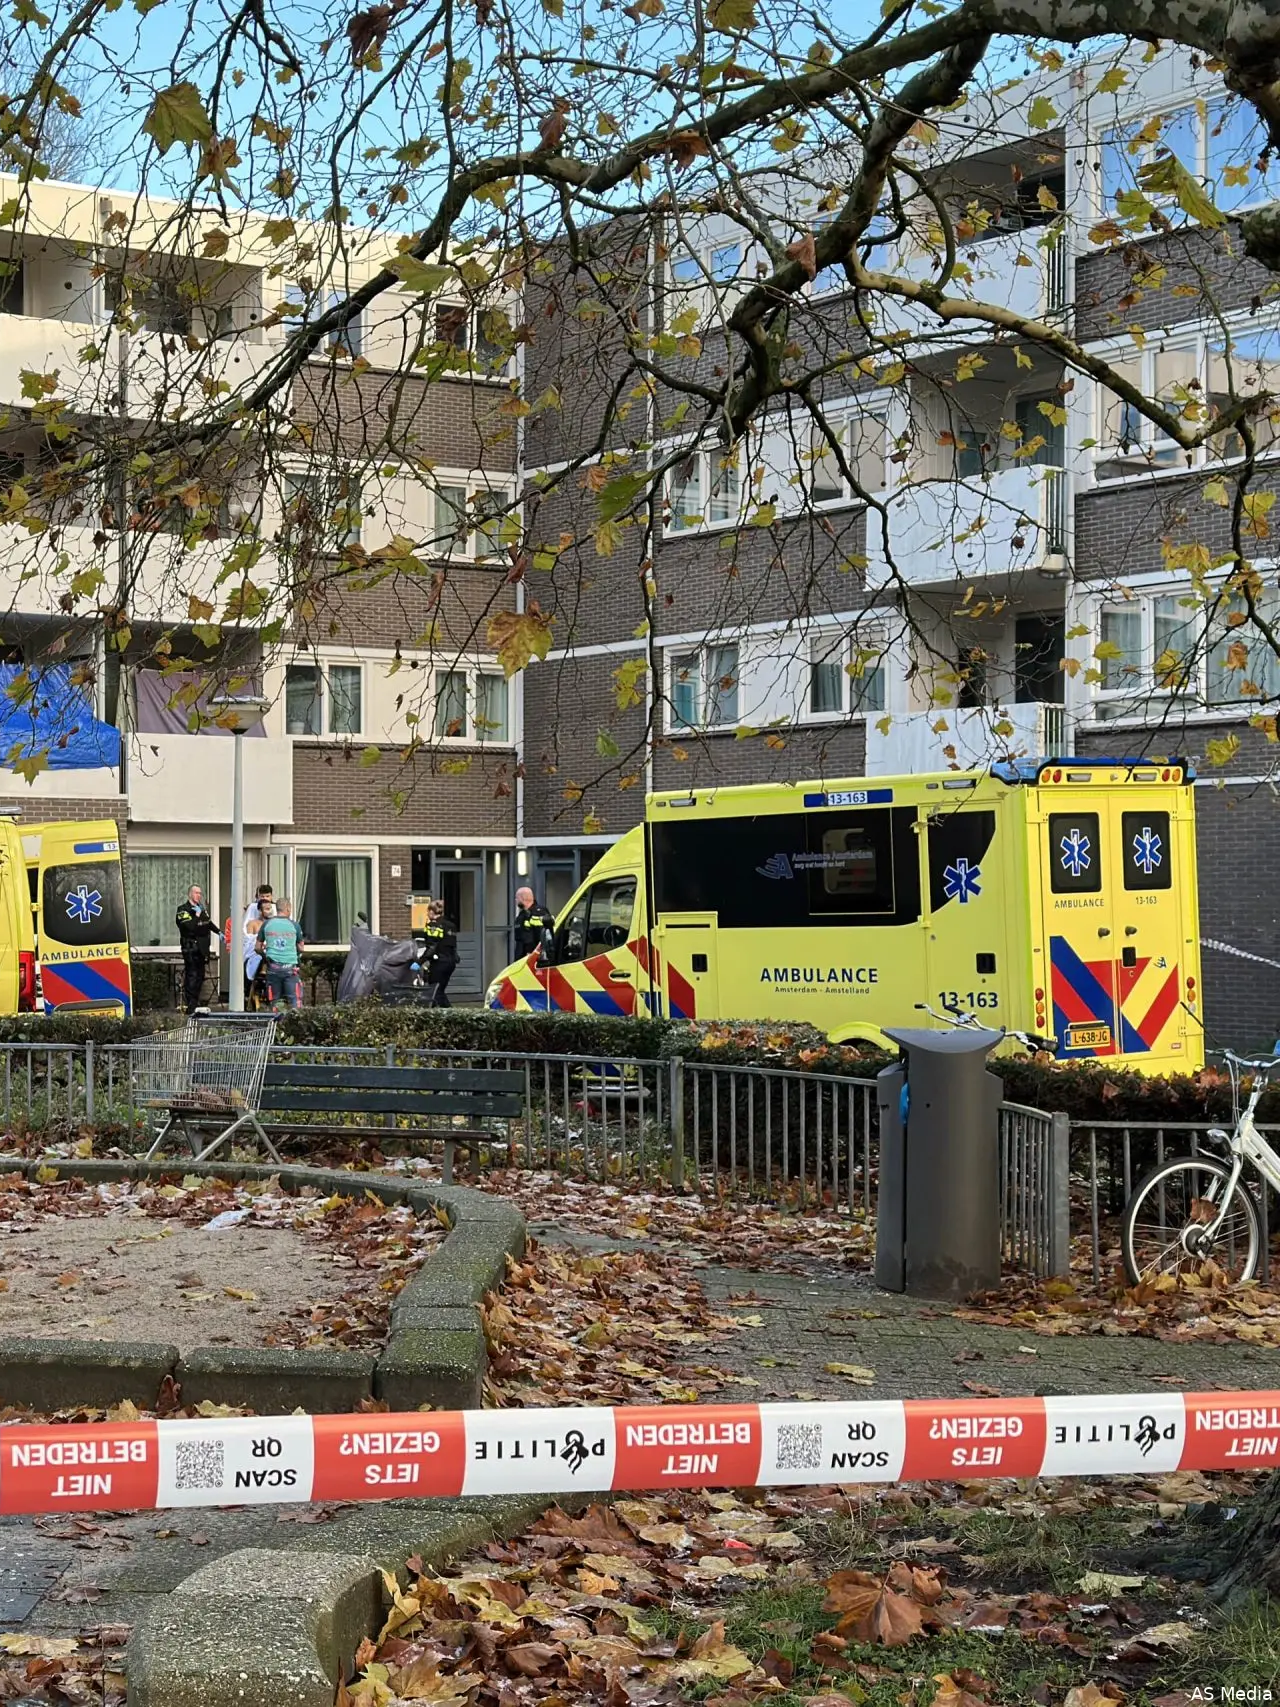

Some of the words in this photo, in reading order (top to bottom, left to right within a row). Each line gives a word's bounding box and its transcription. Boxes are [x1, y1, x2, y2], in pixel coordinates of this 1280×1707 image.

[830, 792, 866, 805] 13-163
[1054, 898, 1105, 909] AMBULANCE
[1135, 896, 1157, 905] 13-163
[41, 946, 120, 962] AMBULANCE
[760, 968, 879, 983] AMBULANCE
[775, 986, 818, 994] Amsterdam
[825, 986, 870, 994] Amstelland
[938, 991, 999, 1008] 13-163
[1074, 1030, 1108, 1044] L-638-JG
[626, 1423, 751, 1446] BETREDEN
[847, 1421, 876, 1441] QR
[928, 1417, 1023, 1439] GEZIEN?
[252, 1438, 282, 1458] QR
[339, 1431, 440, 1455] GEZIEN?
[1225, 1437, 1279, 1457] NIET
[11, 1440, 147, 1467] BETREDEN
[831, 1451, 889, 1469] SCAN
[951, 1447, 1003, 1466] IETS
[365, 1463, 419, 1484] IETS
[661, 1454, 718, 1475] NIET
[51, 1473, 112, 1497] NIET
[235, 1469, 297, 1488] SCAN
